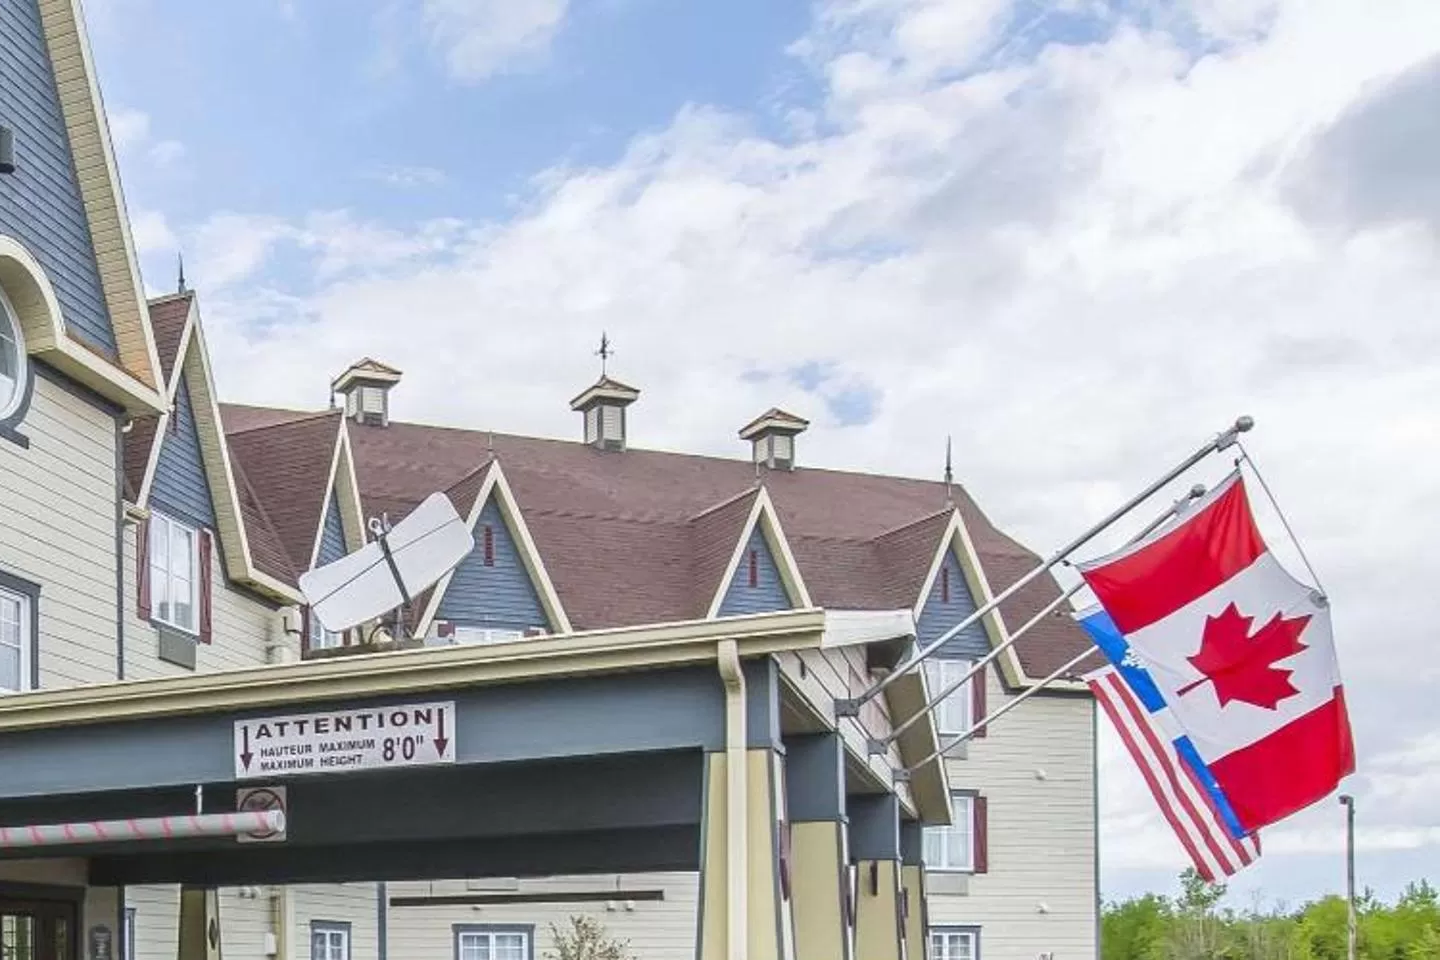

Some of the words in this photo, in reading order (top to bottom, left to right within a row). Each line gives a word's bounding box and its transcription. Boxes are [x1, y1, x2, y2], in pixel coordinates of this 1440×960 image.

[255, 708, 432, 740] ATTENTION
[260, 743, 313, 758] HAUTEUR
[318, 738, 376, 753] MAXIMUM
[382, 735, 424, 762] 8'0"
[260, 757, 314, 771] MAXIMUM
[320, 753, 363, 767] HEIGHT
